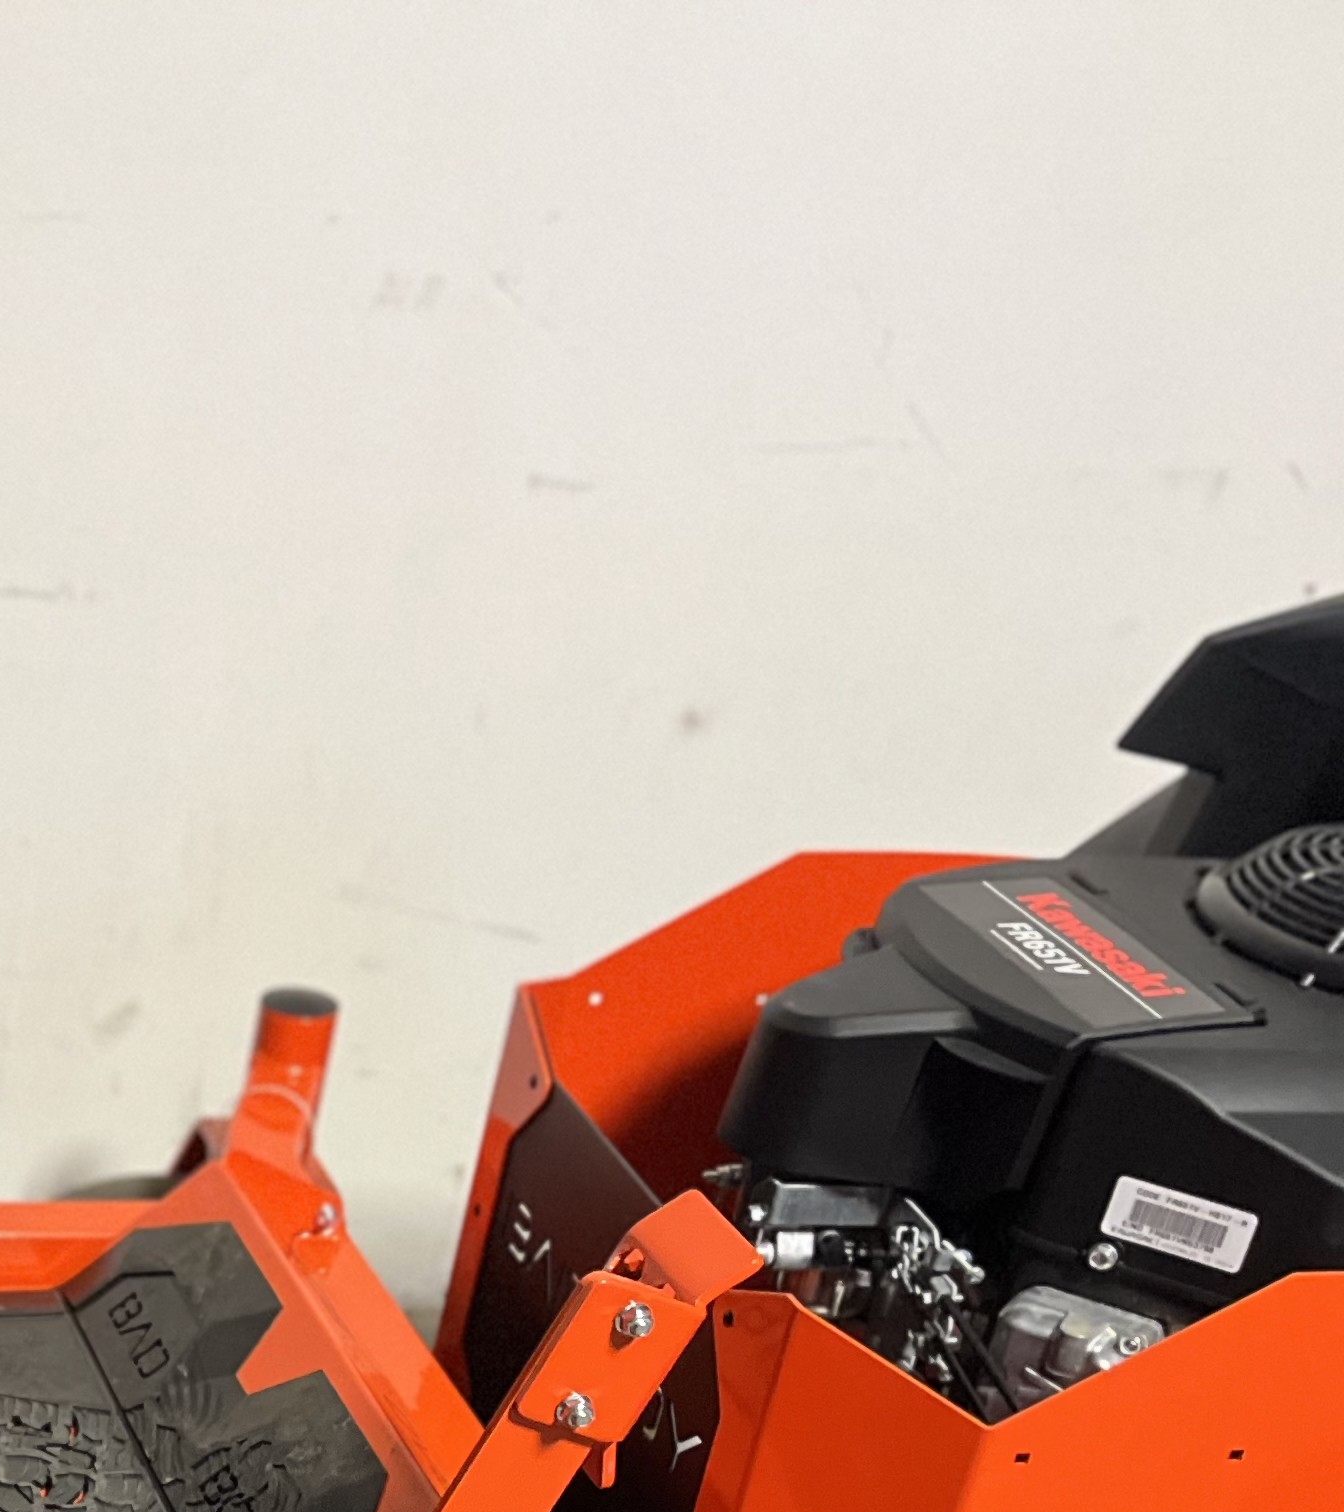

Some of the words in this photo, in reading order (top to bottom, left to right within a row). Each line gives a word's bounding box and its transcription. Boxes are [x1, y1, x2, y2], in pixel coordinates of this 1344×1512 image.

[996, 921, 1092, 975] FR651V
[1015, 892, 1186, 998] Kawasaki
[108, 1291, 171, 1379] BAD
